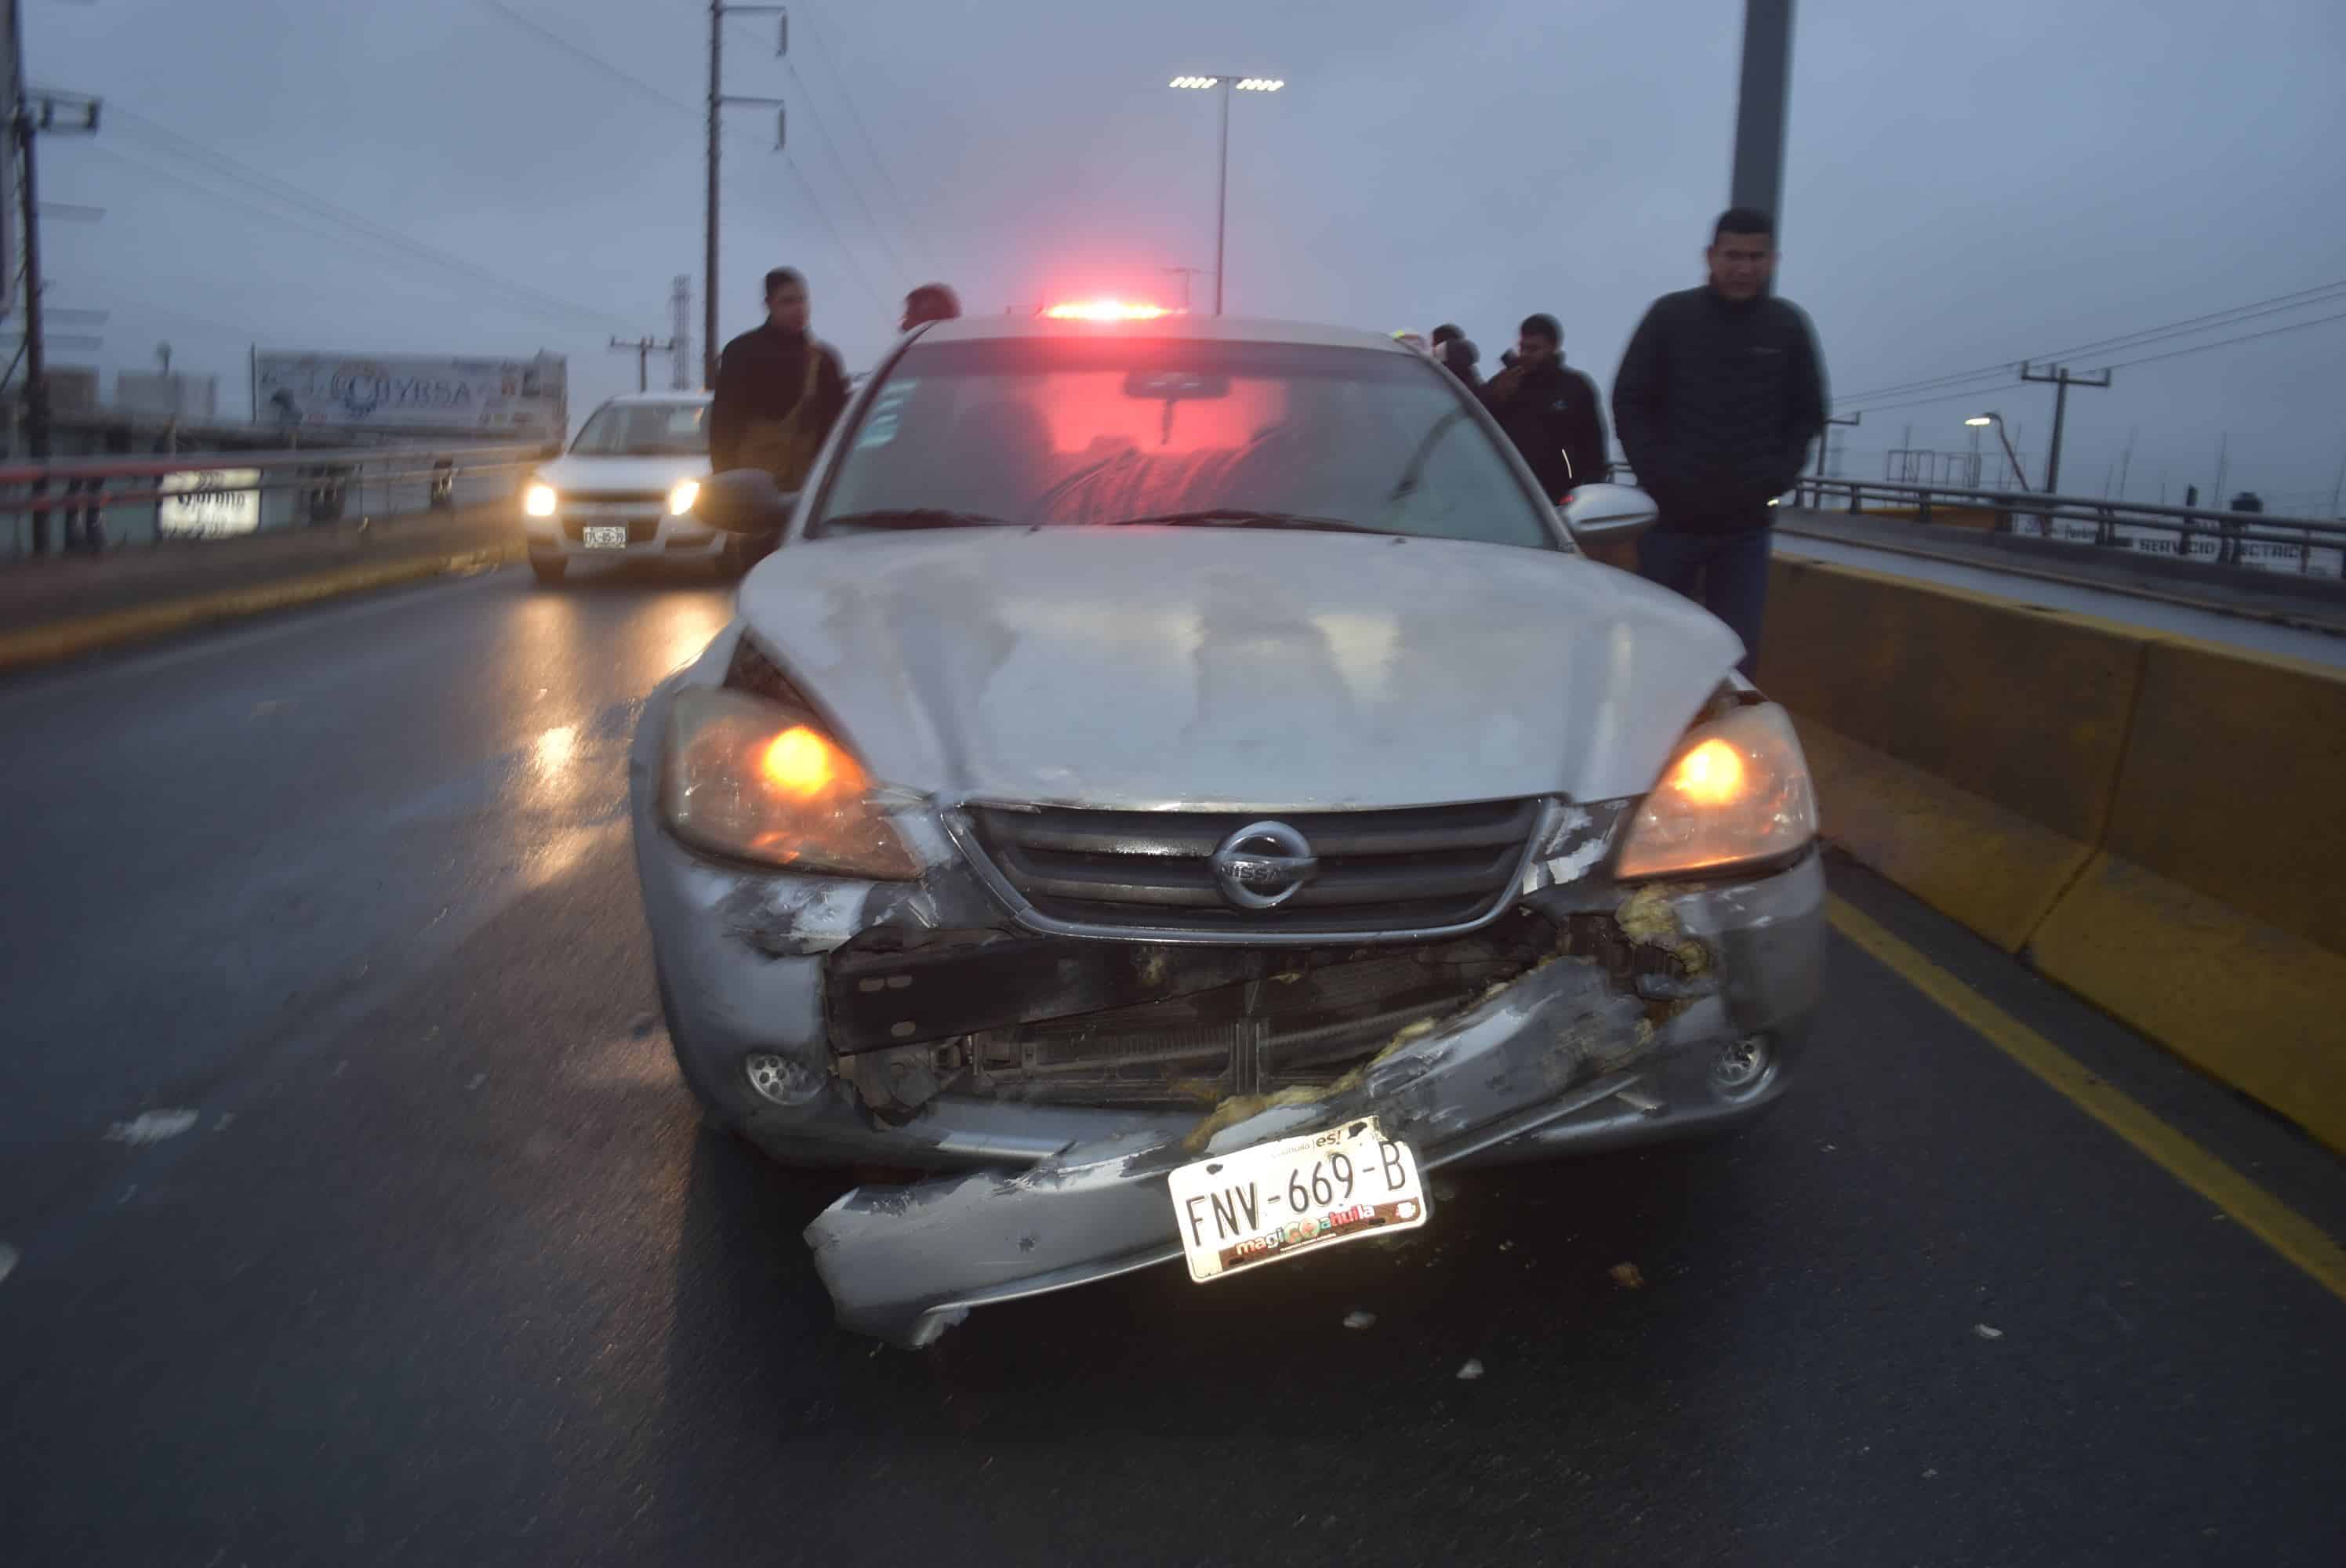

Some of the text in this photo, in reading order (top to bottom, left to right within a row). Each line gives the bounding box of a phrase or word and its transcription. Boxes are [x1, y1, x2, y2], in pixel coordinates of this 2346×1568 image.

[2138, 537, 2217, 555] SERVCIO
[1316, 1129, 1342, 1148] es!
[1186, 1141, 1406, 1247] FNV-669-B
